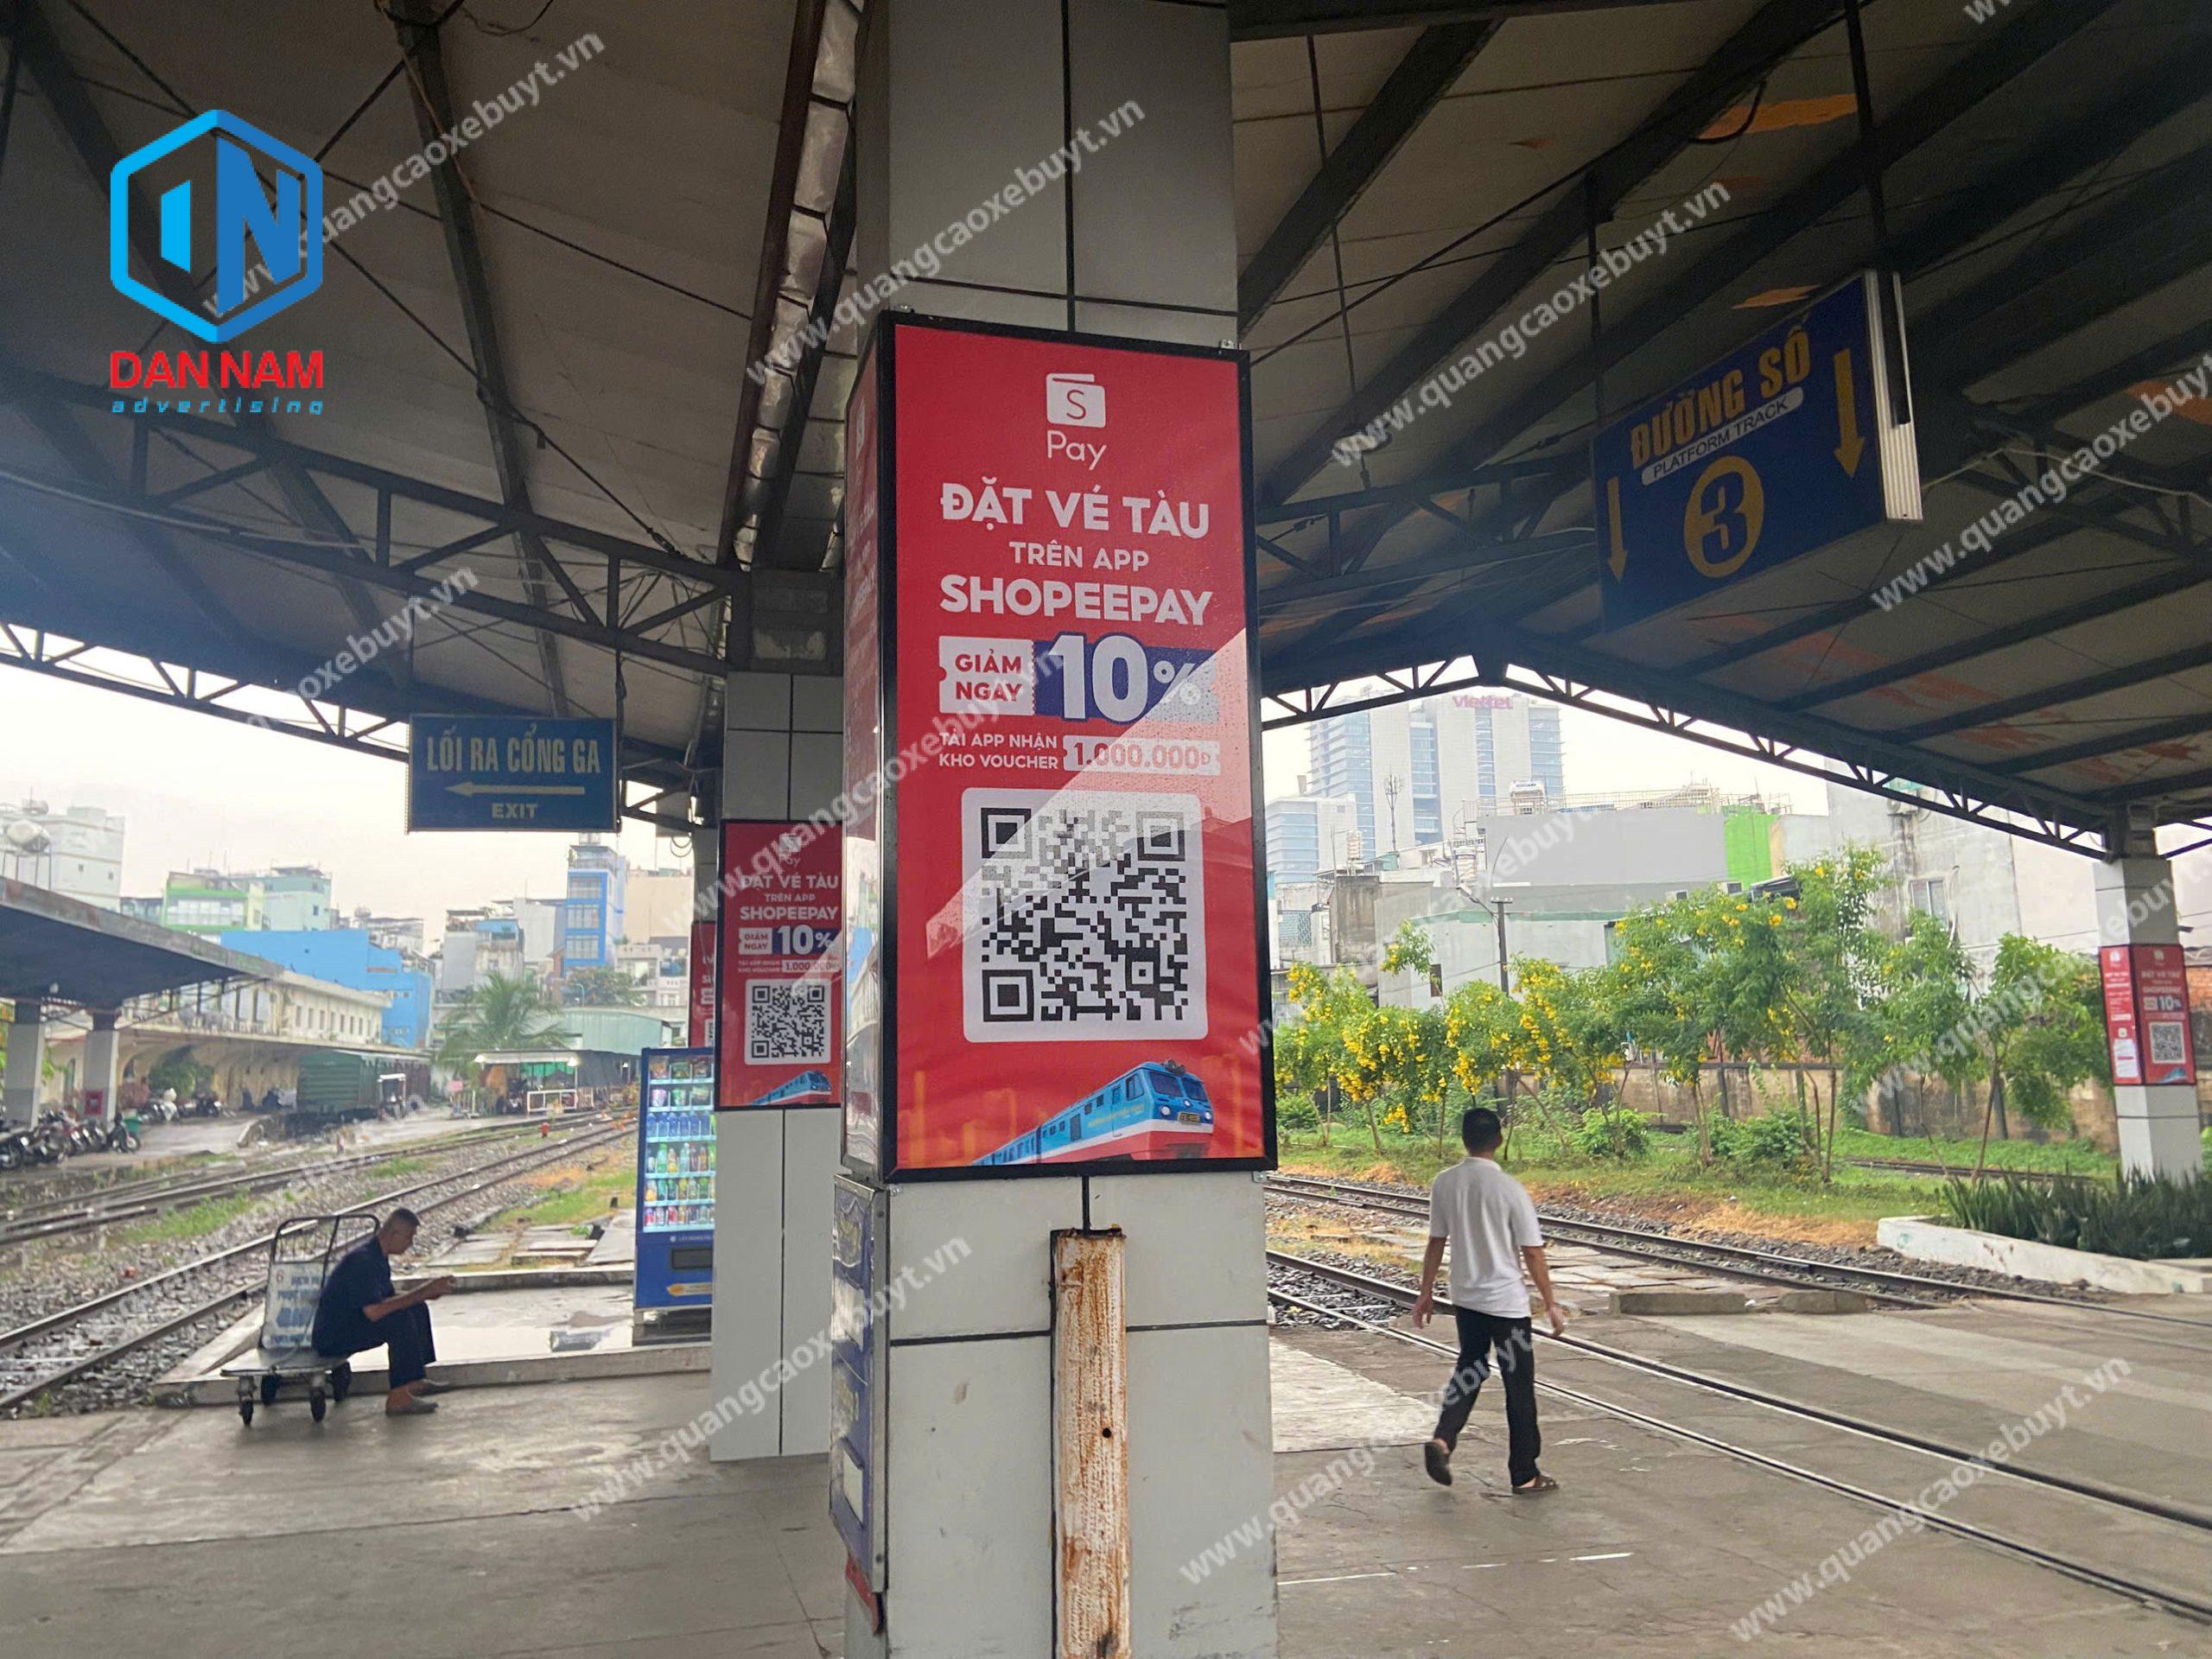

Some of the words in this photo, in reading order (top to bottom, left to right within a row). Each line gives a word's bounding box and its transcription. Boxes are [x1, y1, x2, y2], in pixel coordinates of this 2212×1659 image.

[1630, 369, 1746, 470] ĐƯỜNG
[1758, 313, 1811, 398] SỐ
[1046, 429, 1107, 470] Pay
[1653, 429, 1729, 478] PLATFORM
[1733, 397, 1789, 435] TRACK
[940, 476, 1032, 531] ĐẶT
[1046, 484, 1109, 531] VÉ
[1123, 489, 1210, 538] TÀU
[1700, 473, 1749, 565] 3
[1009, 539, 1083, 568] TRÊN
[1093, 549, 1149, 571] APP
[940, 575, 1213, 626] SHOPEEPAY
[955, 649, 1021, 674] GIẢM
[956, 682, 1022, 702] NGAY
[1047, 635, 1202, 722] 10%
[427, 726, 462, 772] LỐI
[470, 737, 499, 772] RA
[507, 723, 565, 773] CỔNG
[572, 739, 601, 773] GA
[939, 728, 966, 747] TẢI
[971, 734, 1005, 748] APP
[1009, 732, 1058, 751] NHẬN
[939, 753, 976, 767] KHO
[979, 754, 1058, 771] VOUCHER
[492, 804, 538, 819] EXIT
[779, 872, 801, 888] VÉ
[806, 871, 839, 888] TÀU
[740, 906, 838, 920] SHOPEEPAY
[794, 893, 816, 902] APP
[778, 924, 833, 955] 10%
